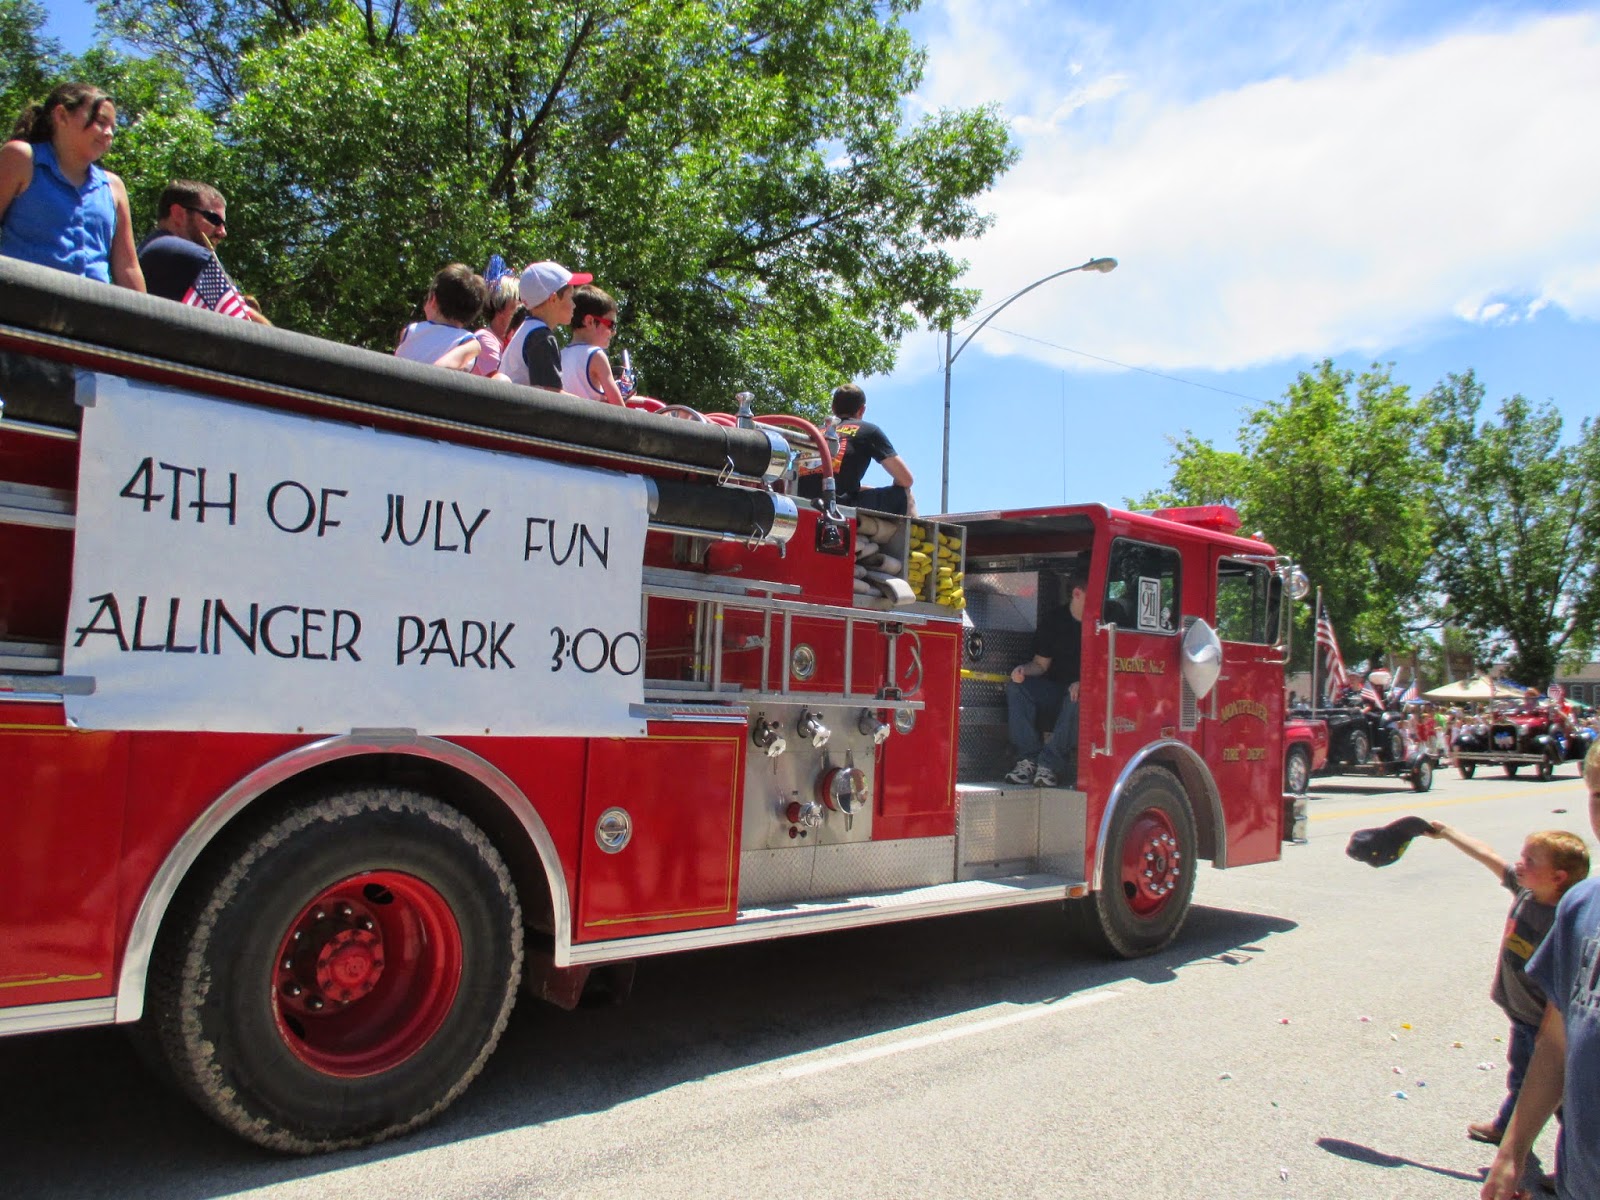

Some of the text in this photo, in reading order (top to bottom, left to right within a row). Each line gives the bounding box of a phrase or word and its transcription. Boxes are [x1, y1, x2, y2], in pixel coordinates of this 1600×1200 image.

[120, 457, 609, 569] 4TH OF JULY FUN
[1142, 590, 1156, 616] 911
[73, 593, 641, 675] ALLINGER PARK 3:00
[1114, 656, 1145, 673] ENGINE
[1223, 748, 1240, 761] FIRE
